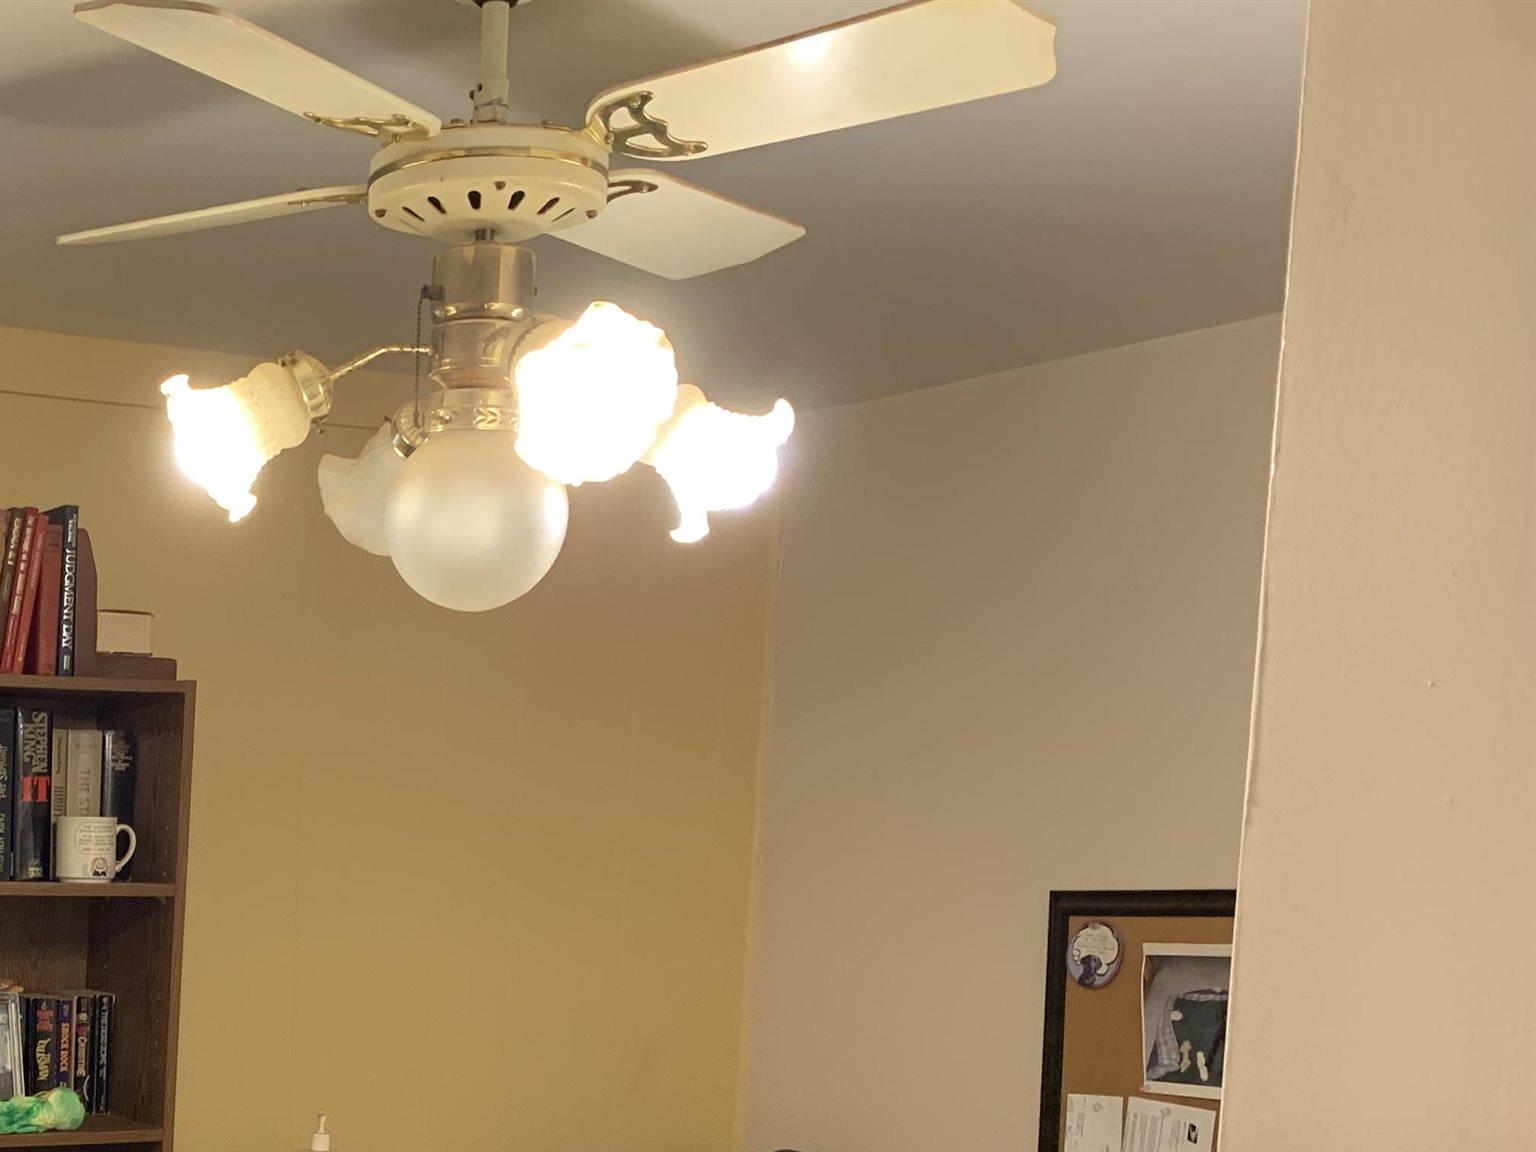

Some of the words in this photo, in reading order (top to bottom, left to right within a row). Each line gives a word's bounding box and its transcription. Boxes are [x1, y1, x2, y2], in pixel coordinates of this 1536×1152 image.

[63, 549, 75, 621] JUDGMENT
[61, 624, 74, 650] DAY
[23, 721, 36, 763] KING
[31, 711, 49, 772] STEPHEN
[21, 776, 52, 803] IT
[61, 1022, 70, 1050] SHOCK
[60, 1050, 69, 1073] ROCK
